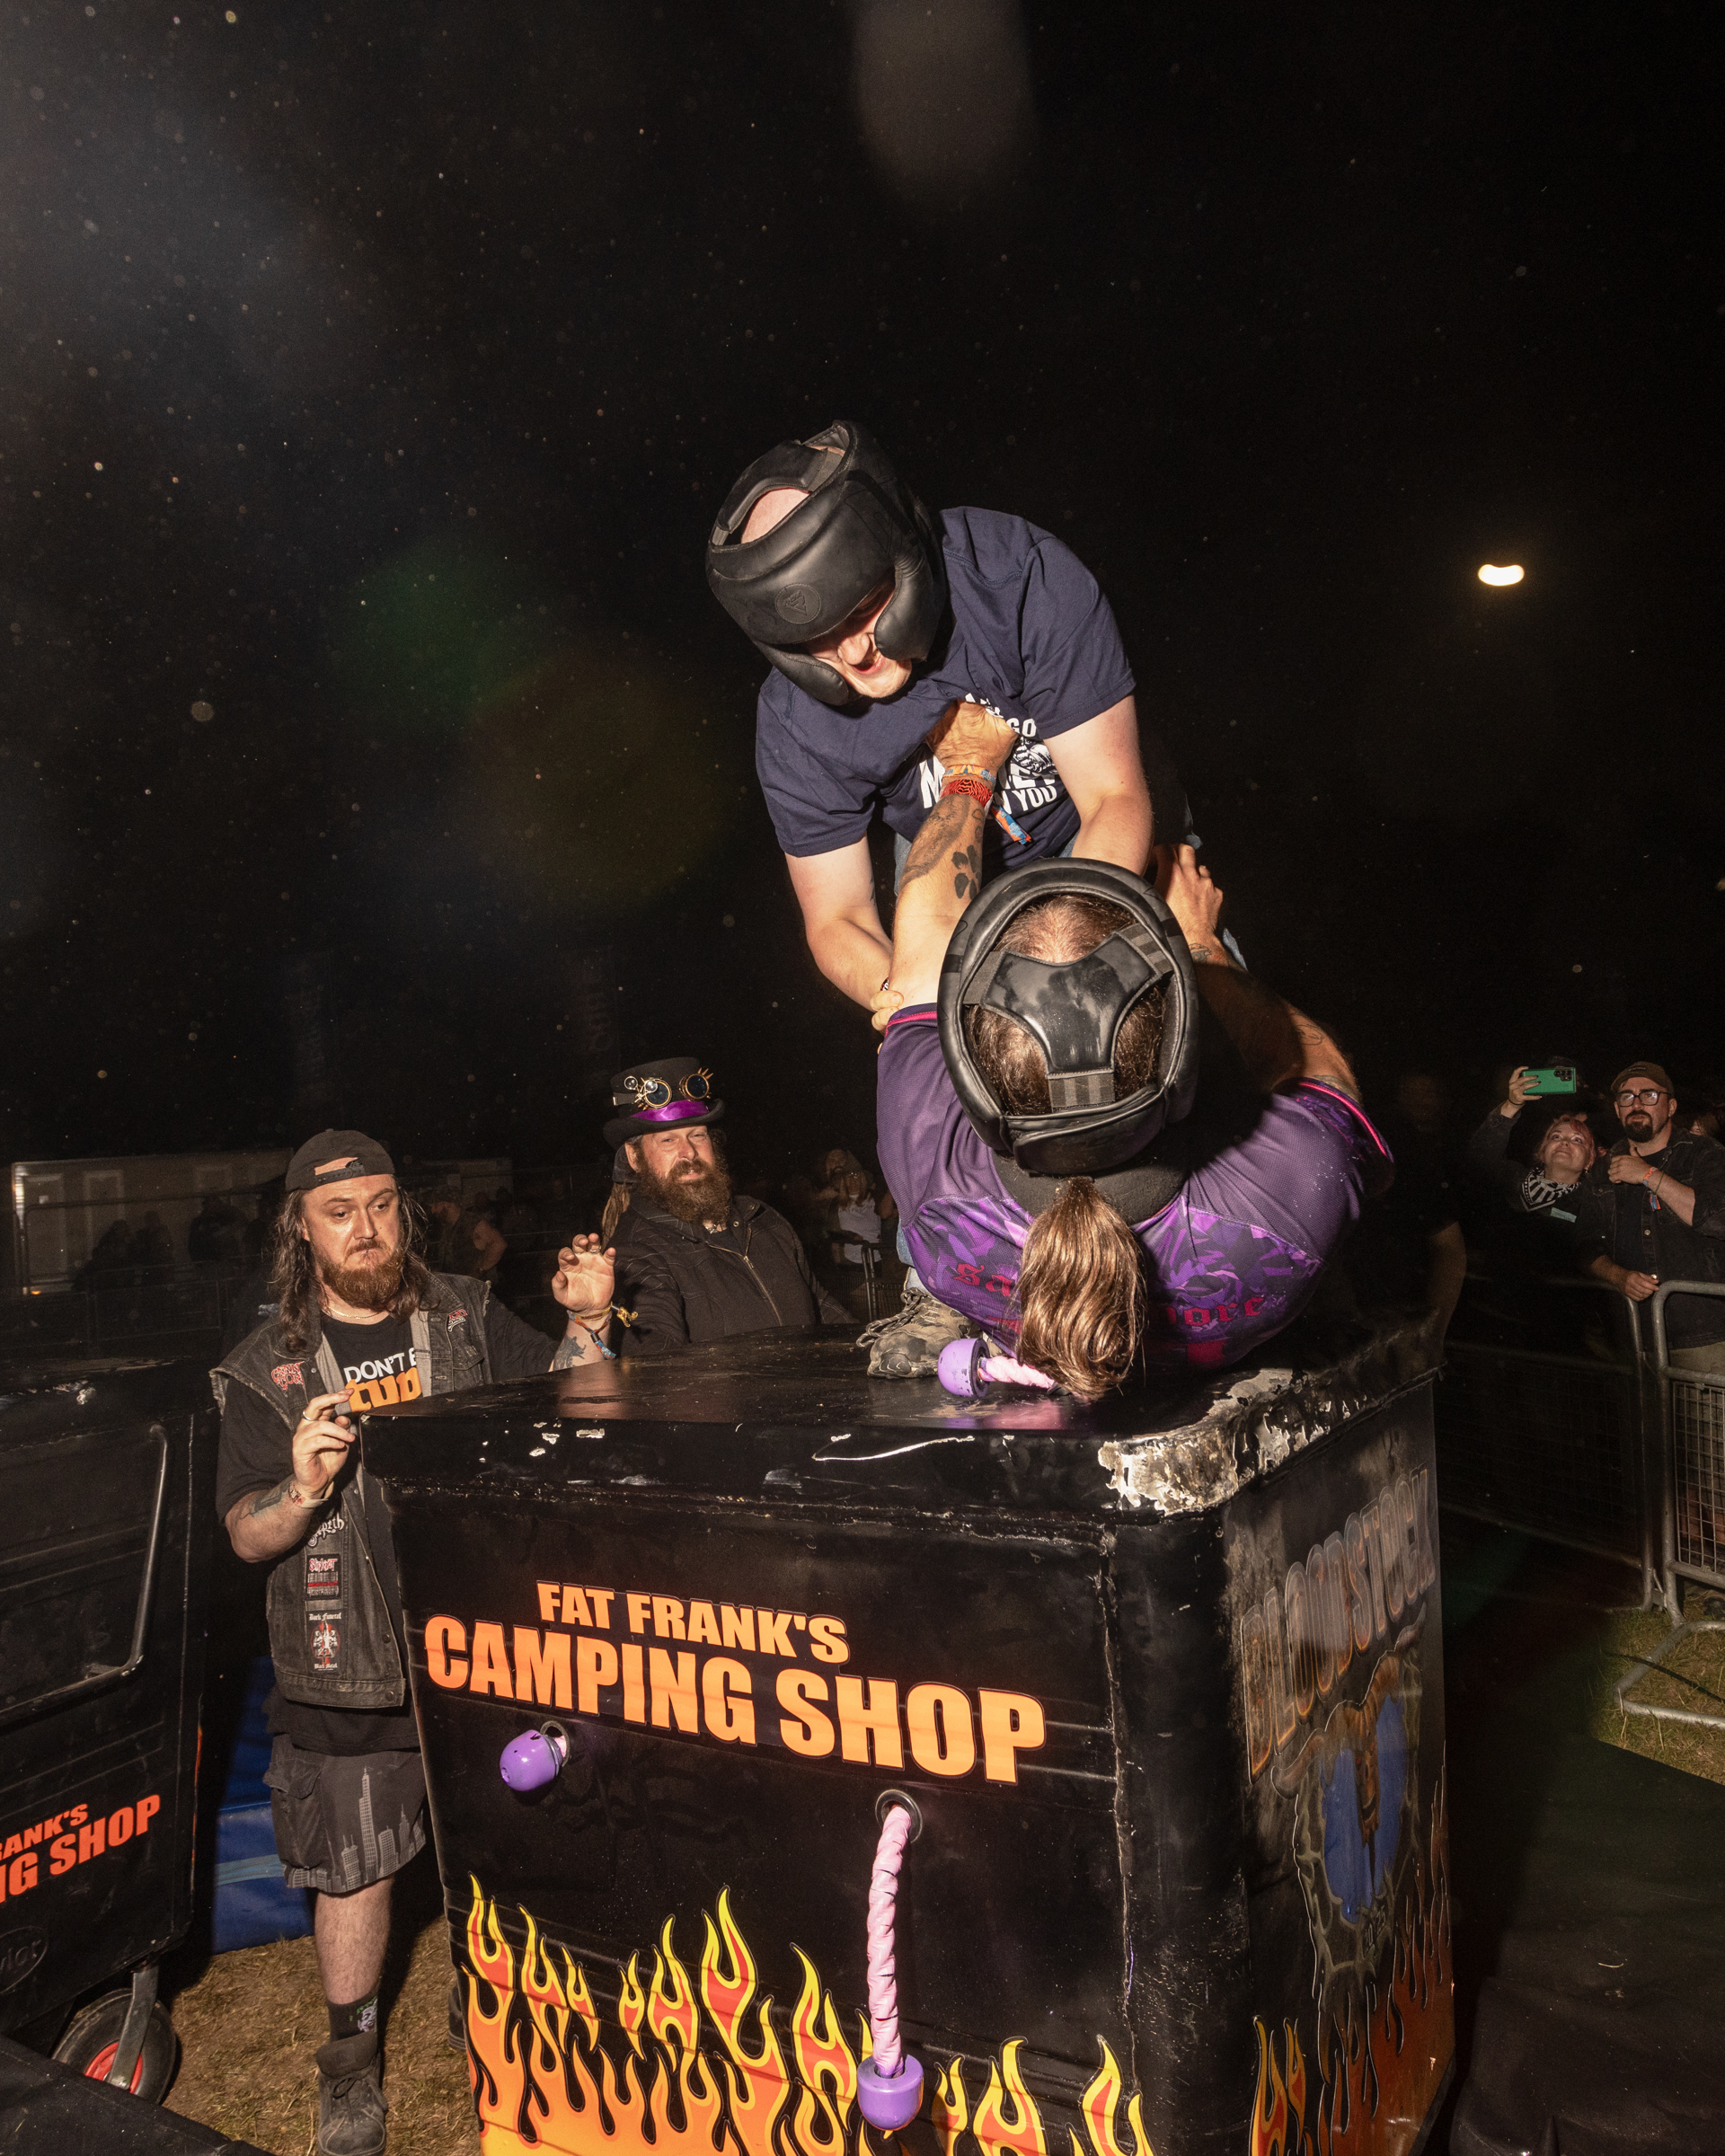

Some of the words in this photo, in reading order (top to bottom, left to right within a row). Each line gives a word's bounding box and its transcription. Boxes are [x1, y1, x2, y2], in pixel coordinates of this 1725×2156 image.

[1012, 785, 1057, 812] YOU
[343, 1352, 405, 1383] DON'T
[537, 1582, 615, 1630] FAT
[626, 1590, 850, 1664] FRANK'S
[425, 1617, 757, 1746] CAMPING
[776, 1668, 1046, 1784] SHOP
[0, 1803, 88, 1861] ANK'S
[0, 1851, 39, 1904] G
[49, 1794, 160, 1876] SHOP
